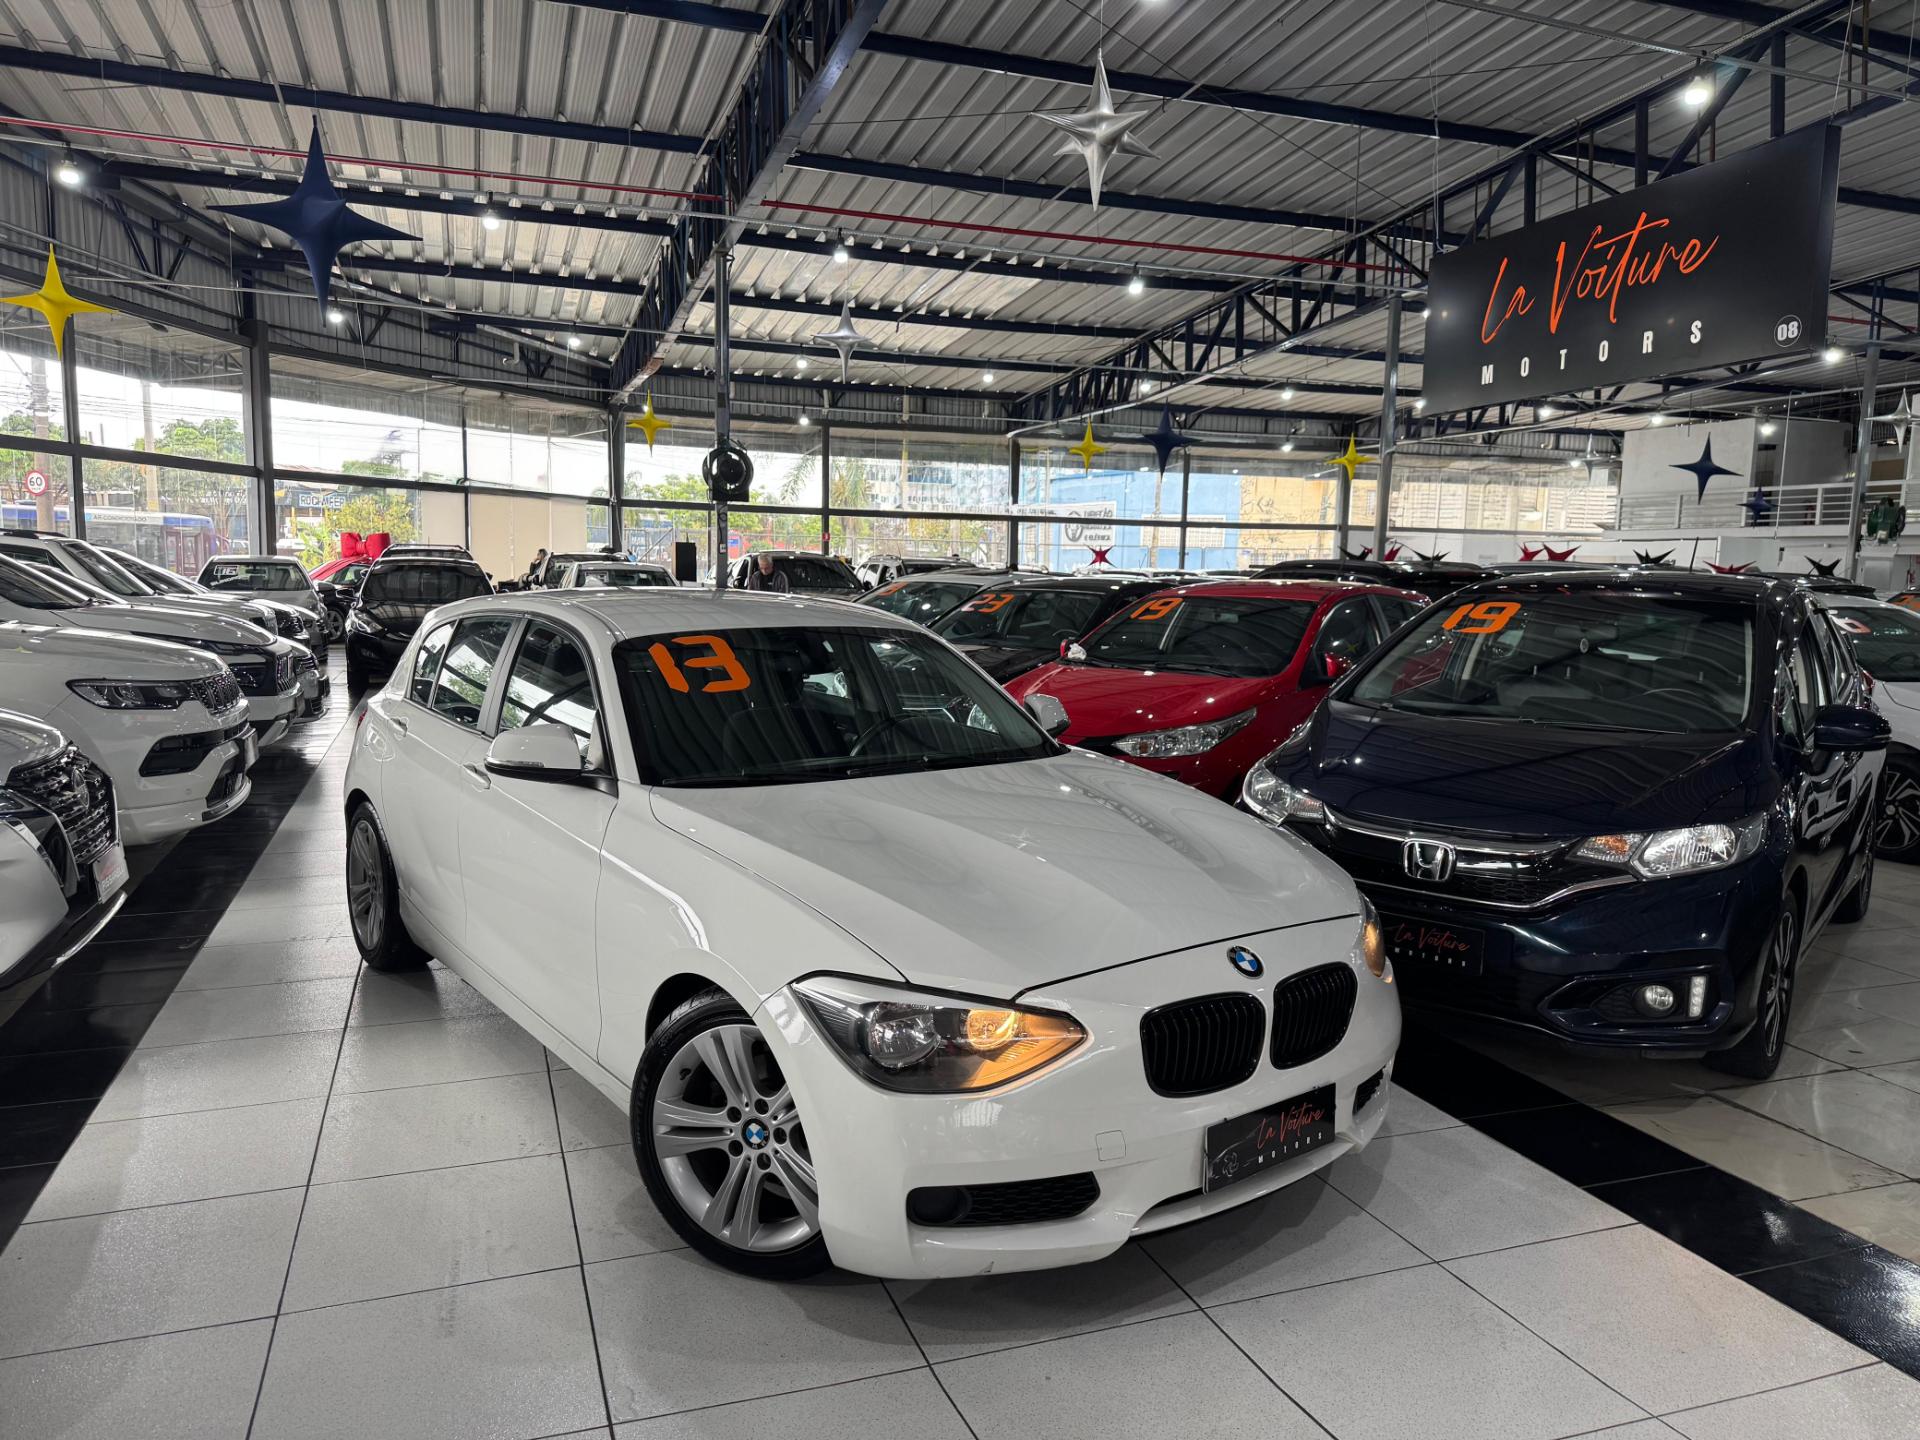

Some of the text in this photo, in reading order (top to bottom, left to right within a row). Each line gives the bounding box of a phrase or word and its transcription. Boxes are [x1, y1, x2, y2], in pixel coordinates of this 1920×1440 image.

[1480, 211, 1720, 345] La Voiture
[1776, 320, 1799, 343] 08
[1480, 319, 1703, 387] MOTORS
[29, 476, 43, 487] 60
[961, 593, 1015, 613] 23
[1130, 597, 1184, 620] 19
[1441, 601, 1521, 634] 19
[648, 634, 751, 693] 13
[1394, 922, 1471, 954] La Voiture
[1256, 1101, 1326, 1150] La Voiture
[1258, 1131, 1322, 1164] MOTORS
